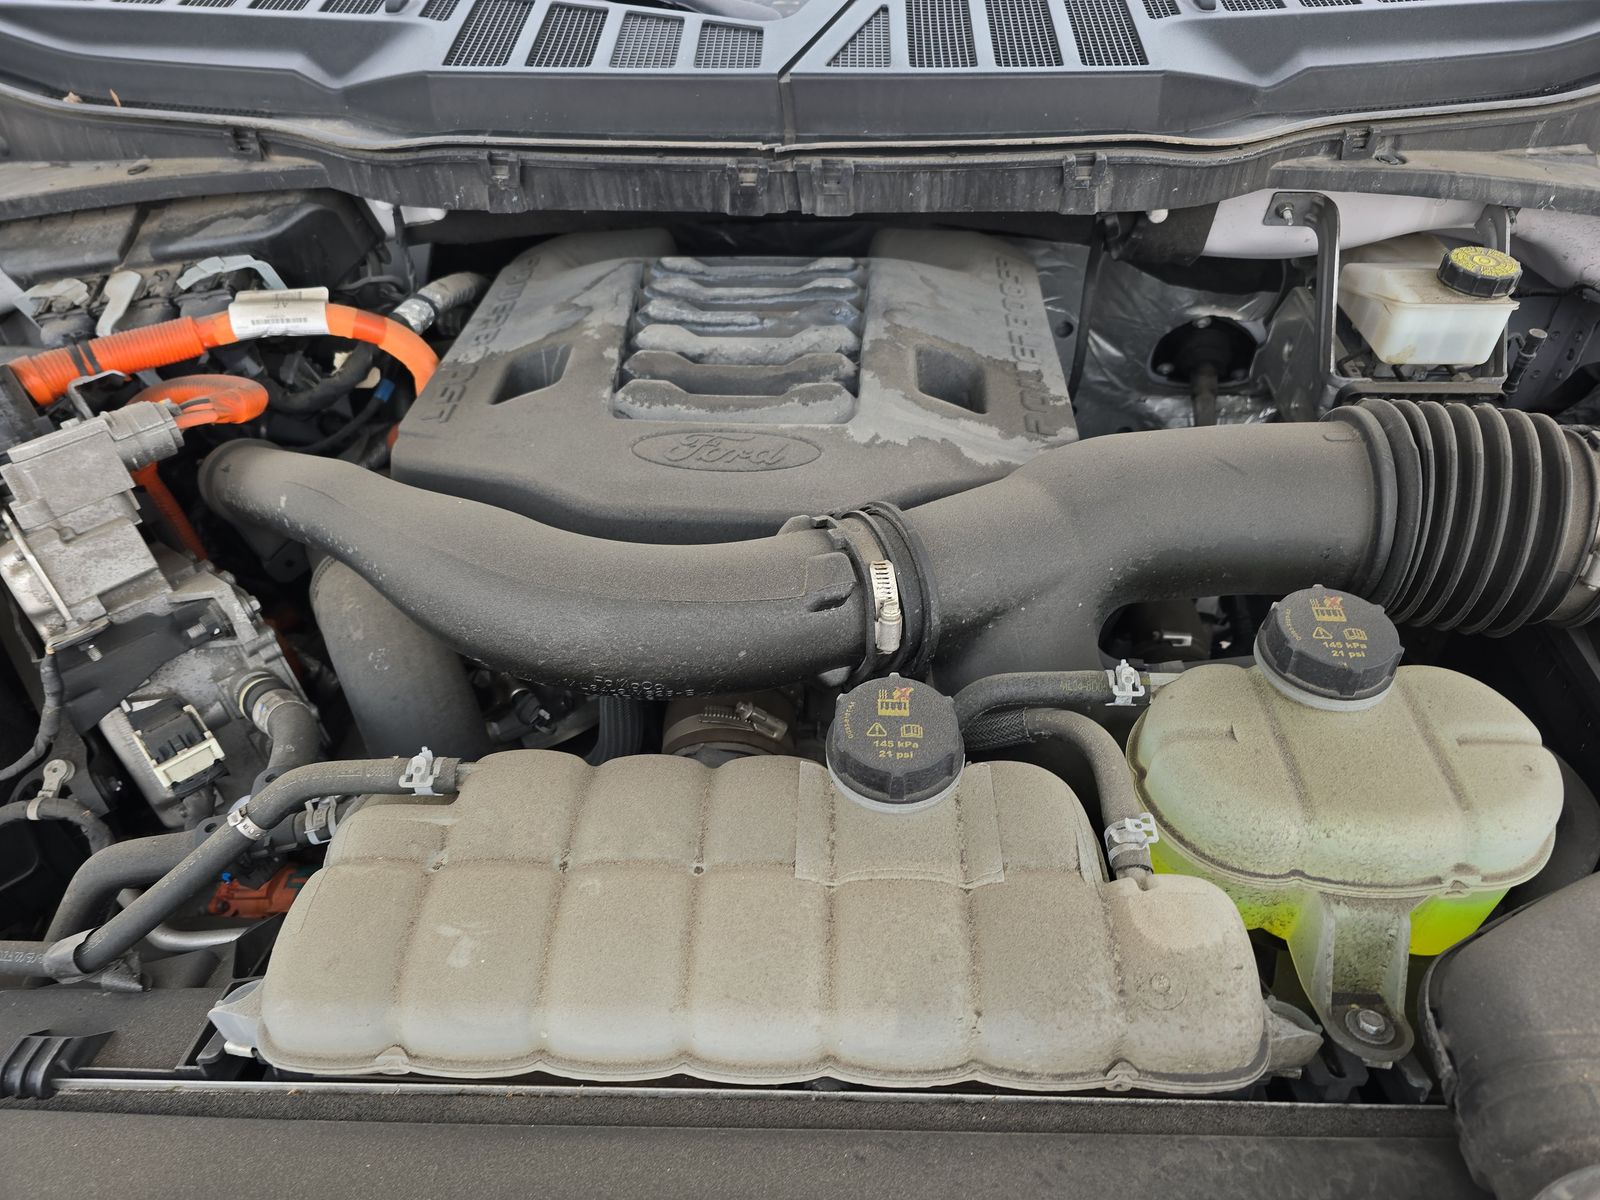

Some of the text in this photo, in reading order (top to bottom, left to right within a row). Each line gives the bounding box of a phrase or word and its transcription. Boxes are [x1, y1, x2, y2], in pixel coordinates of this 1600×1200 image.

[663, 433, 791, 466] Ford
[897, 741, 919, 749] kPa
[879, 750, 914, 759] 21 psi
